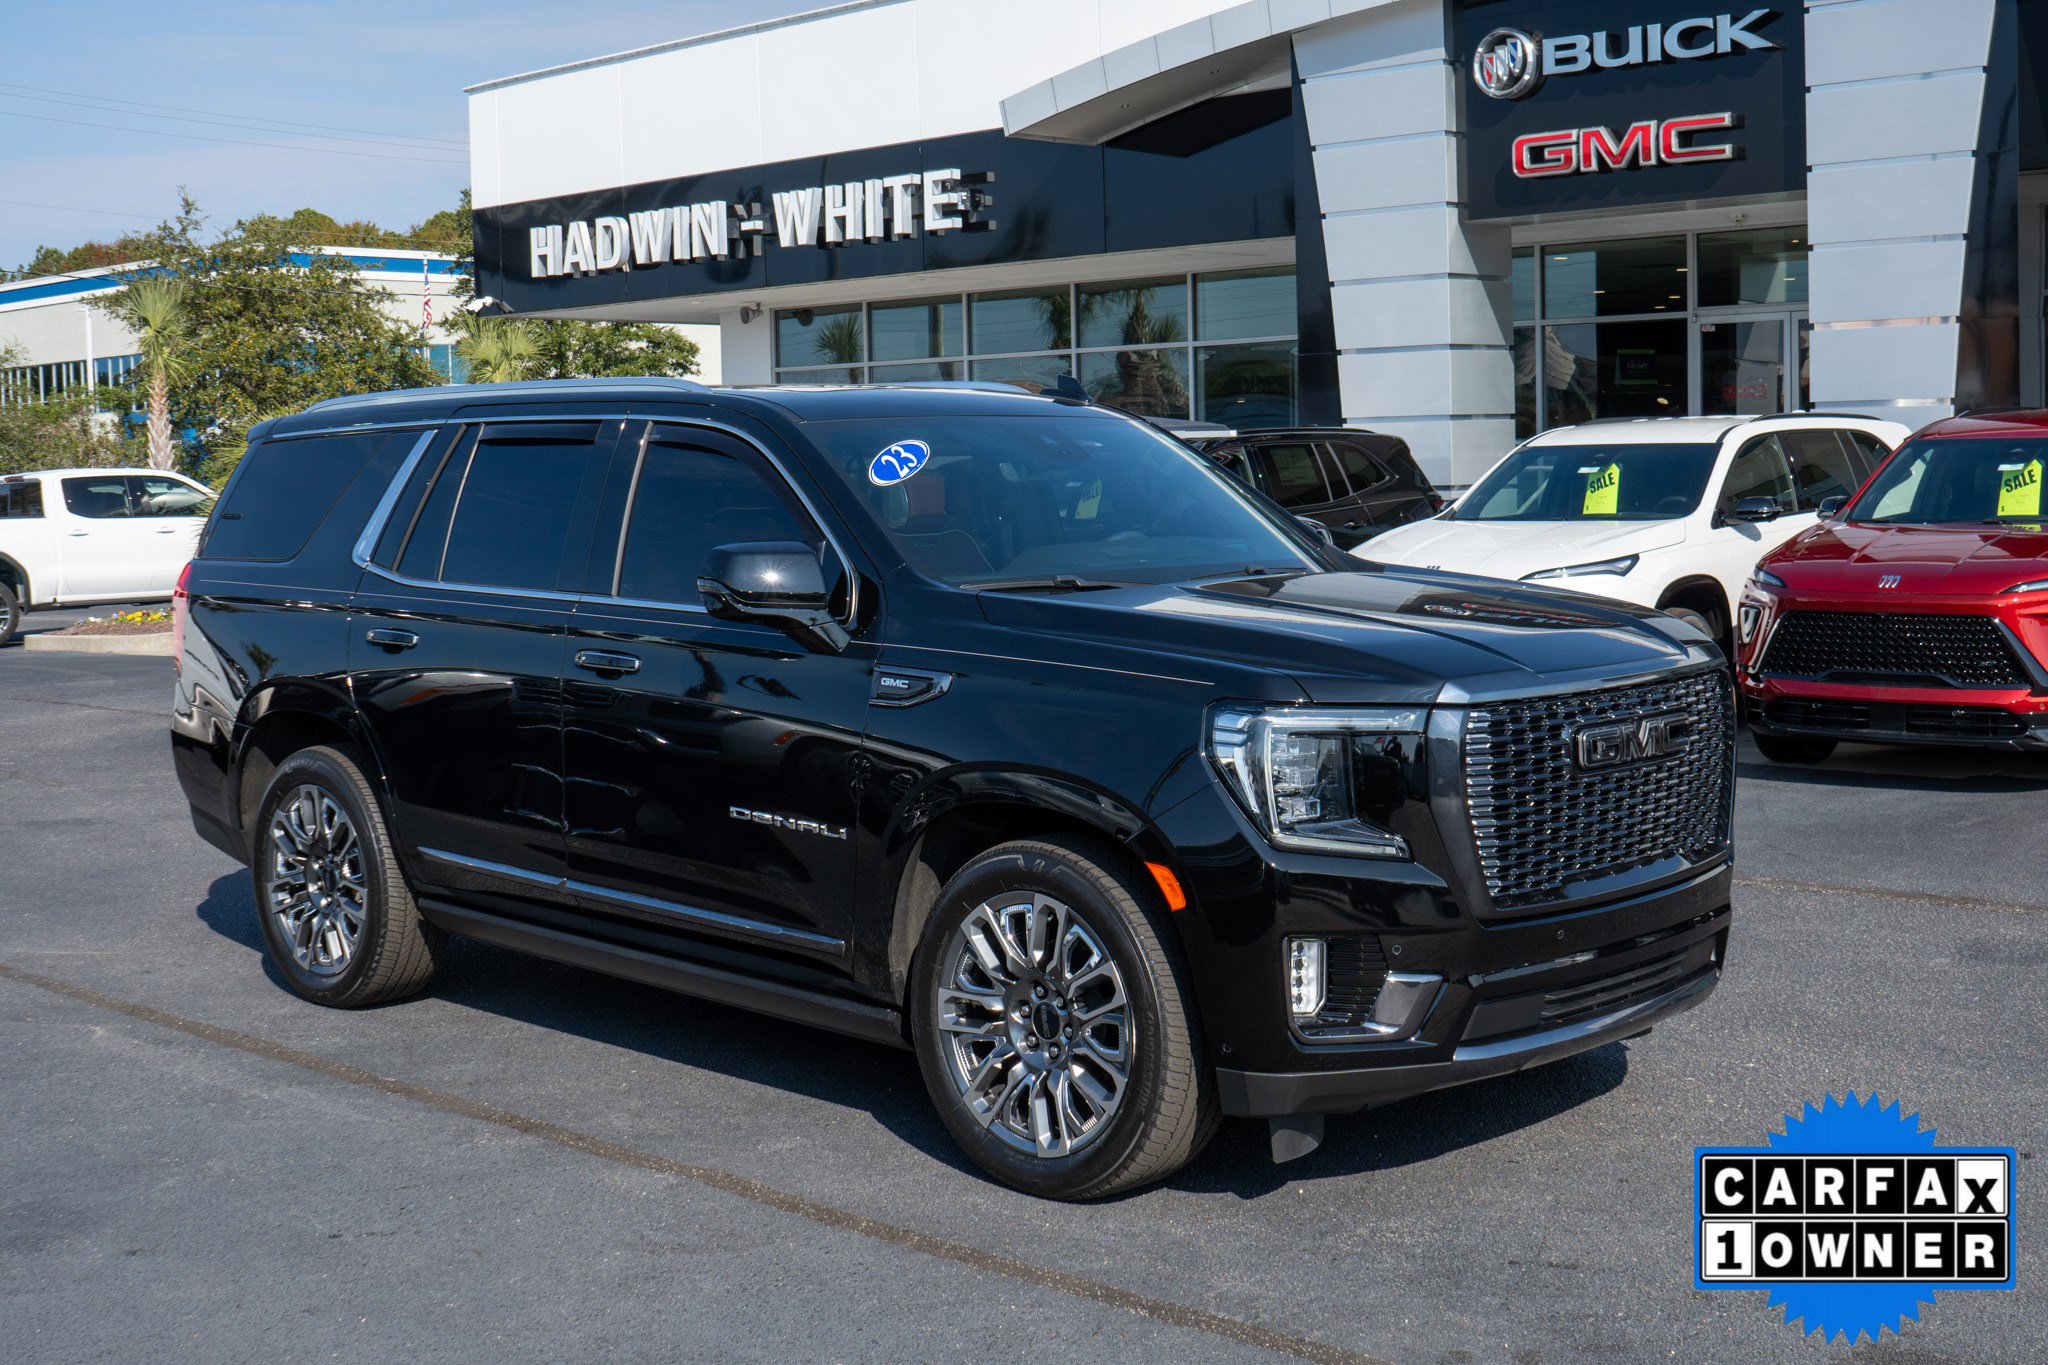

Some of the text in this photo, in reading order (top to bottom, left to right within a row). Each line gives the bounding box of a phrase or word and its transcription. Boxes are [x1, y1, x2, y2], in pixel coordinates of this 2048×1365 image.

[1542, 9, 1778, 76] BUICK
[1512, 112, 1736, 179] GMC
[881, 446, 917, 478] 23
[1590, 472, 1616, 494] SALE
[2004, 469, 2037, 493] SALE
[880, 677, 910, 689] GMC
[1578, 711, 1690, 769] GMC
[729, 805, 847, 840] DENALI
